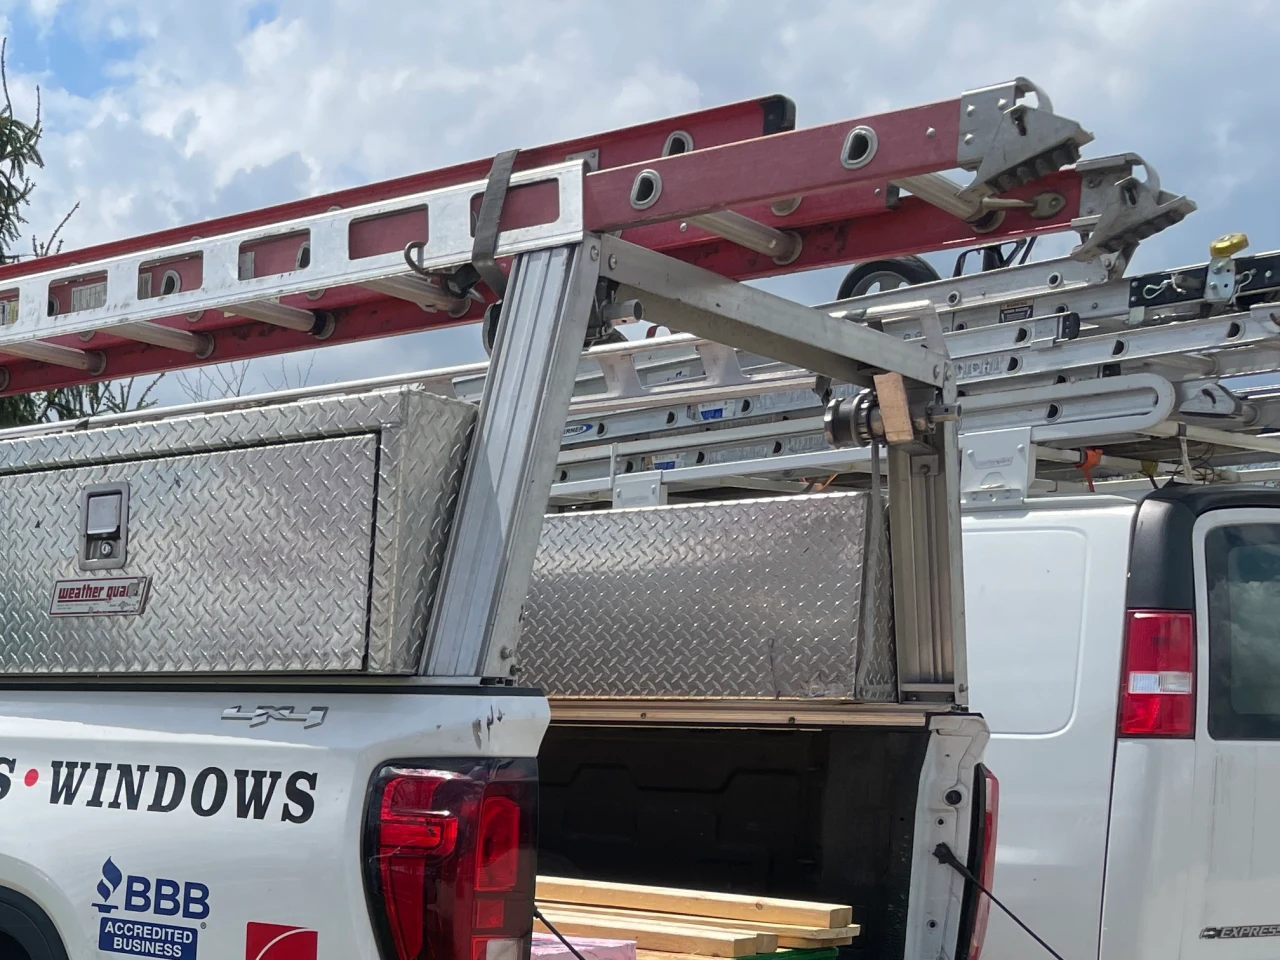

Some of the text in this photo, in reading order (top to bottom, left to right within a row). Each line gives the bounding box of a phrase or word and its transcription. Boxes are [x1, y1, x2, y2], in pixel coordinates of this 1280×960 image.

[58, 583, 139, 601] weather gua
[48, 760, 319, 824] WINDOWS
[124, 875, 210, 920] BBB
[104, 921, 193, 944] ACCREDITED
[113, 937, 183, 958] BUSINESS
